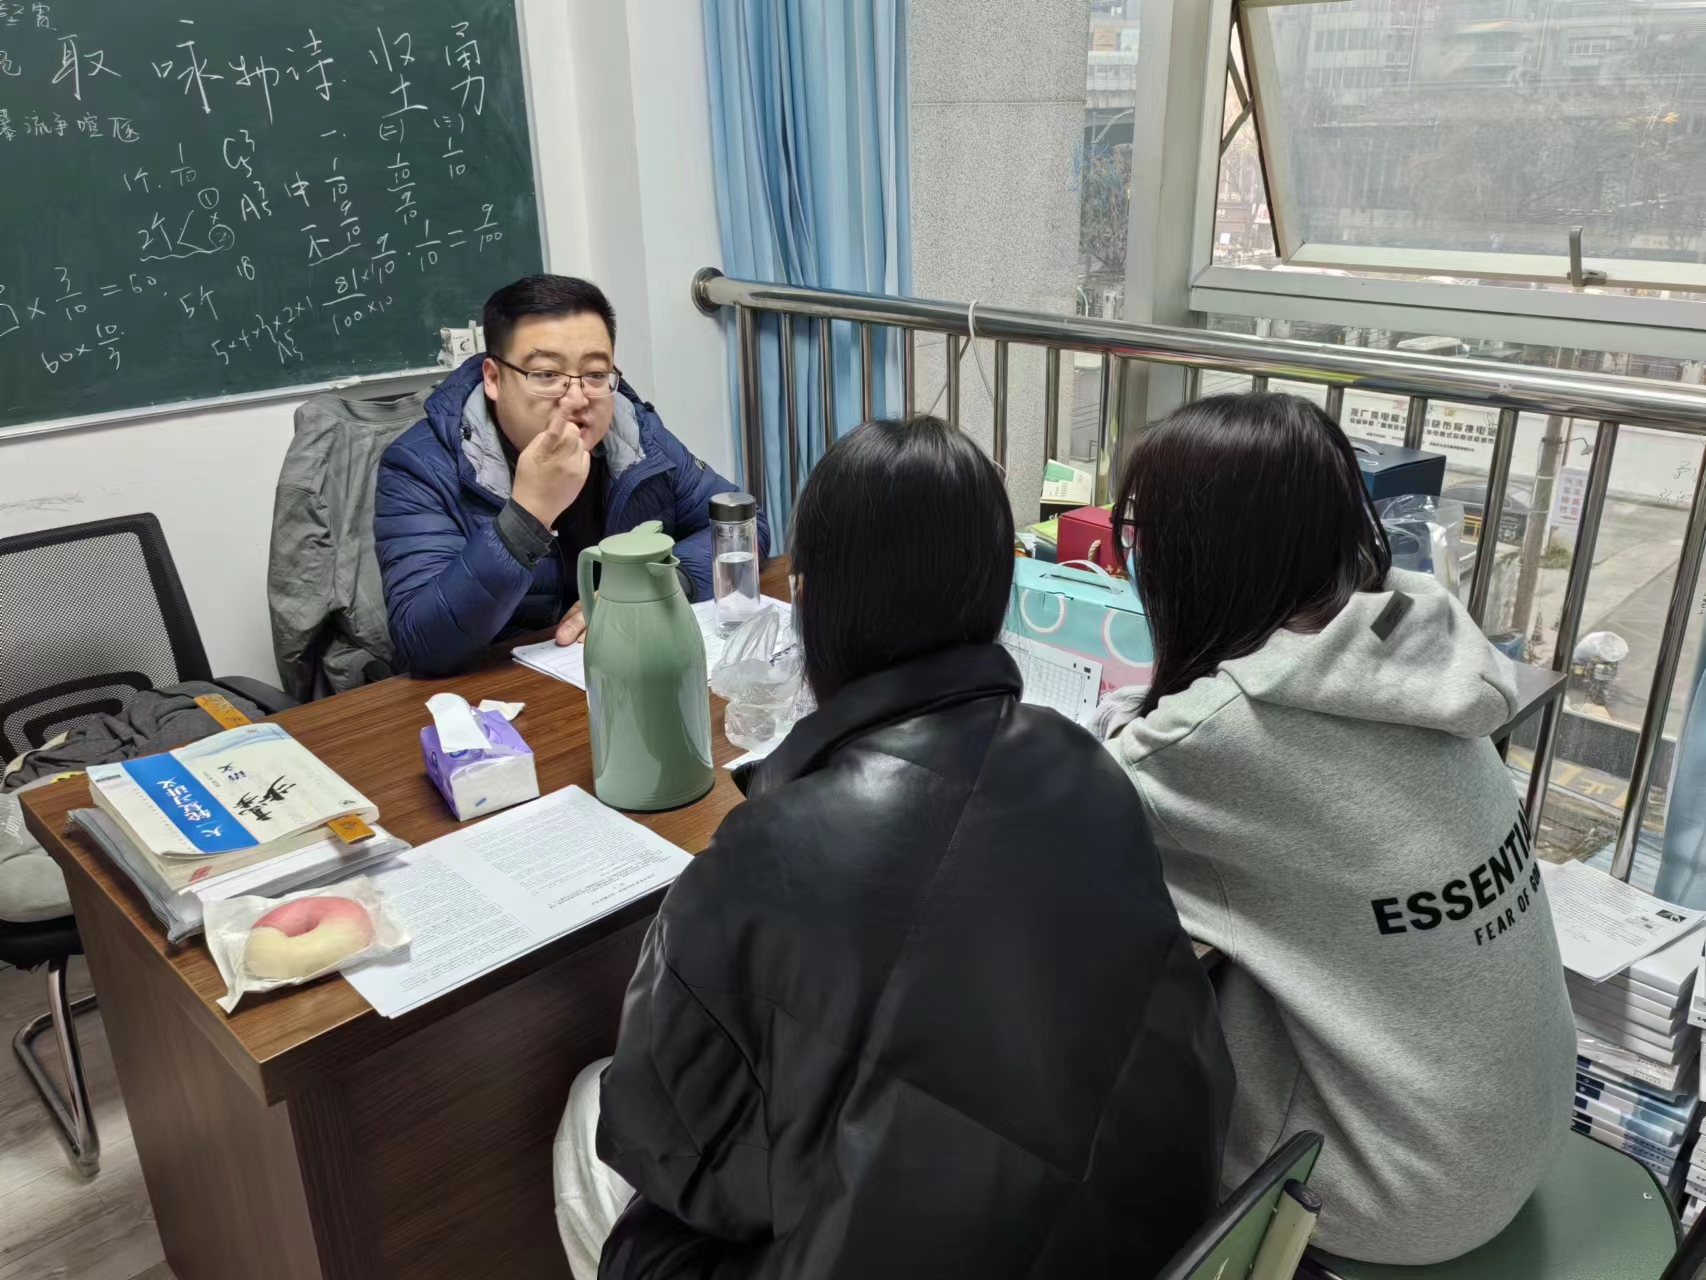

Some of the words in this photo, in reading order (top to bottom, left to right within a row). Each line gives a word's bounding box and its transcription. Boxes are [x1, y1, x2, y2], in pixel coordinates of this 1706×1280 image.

[51, 34, 122, 101] 取
[156, 776, 223, 838] 大一轮复习讲义
[1474, 907, 1515, 946] FEAR
[1517, 887, 1531, 913] OF
